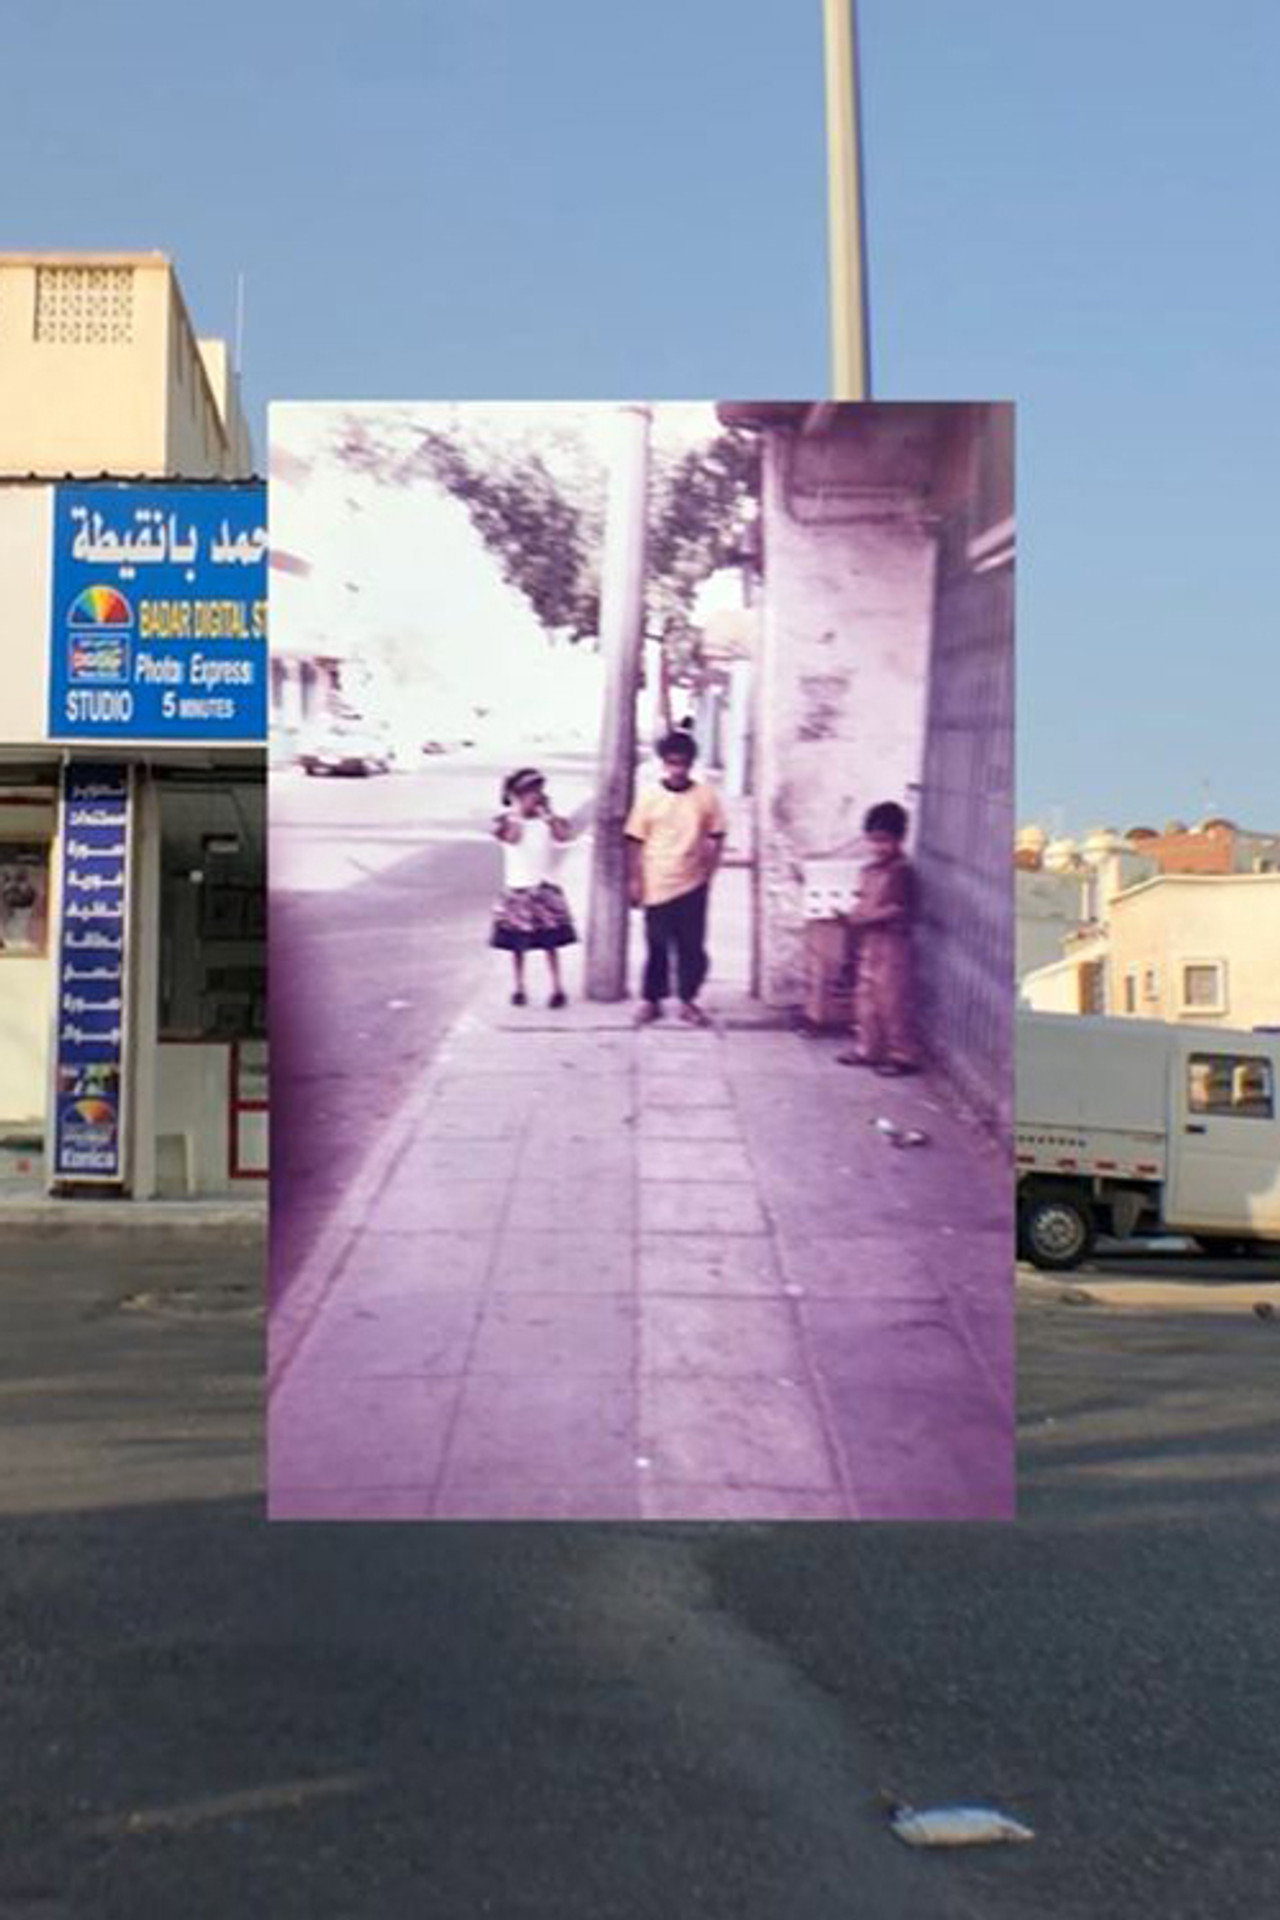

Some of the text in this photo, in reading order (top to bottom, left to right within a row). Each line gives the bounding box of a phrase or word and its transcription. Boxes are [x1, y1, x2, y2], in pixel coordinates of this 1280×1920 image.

[70, 505, 198, 583] بانقيطة
[194, 599, 249, 639] DIGITAL
[189, 652, 254, 692] Express
[65, 689, 133, 722] STUDIO
[161, 690, 176, 719] 5
